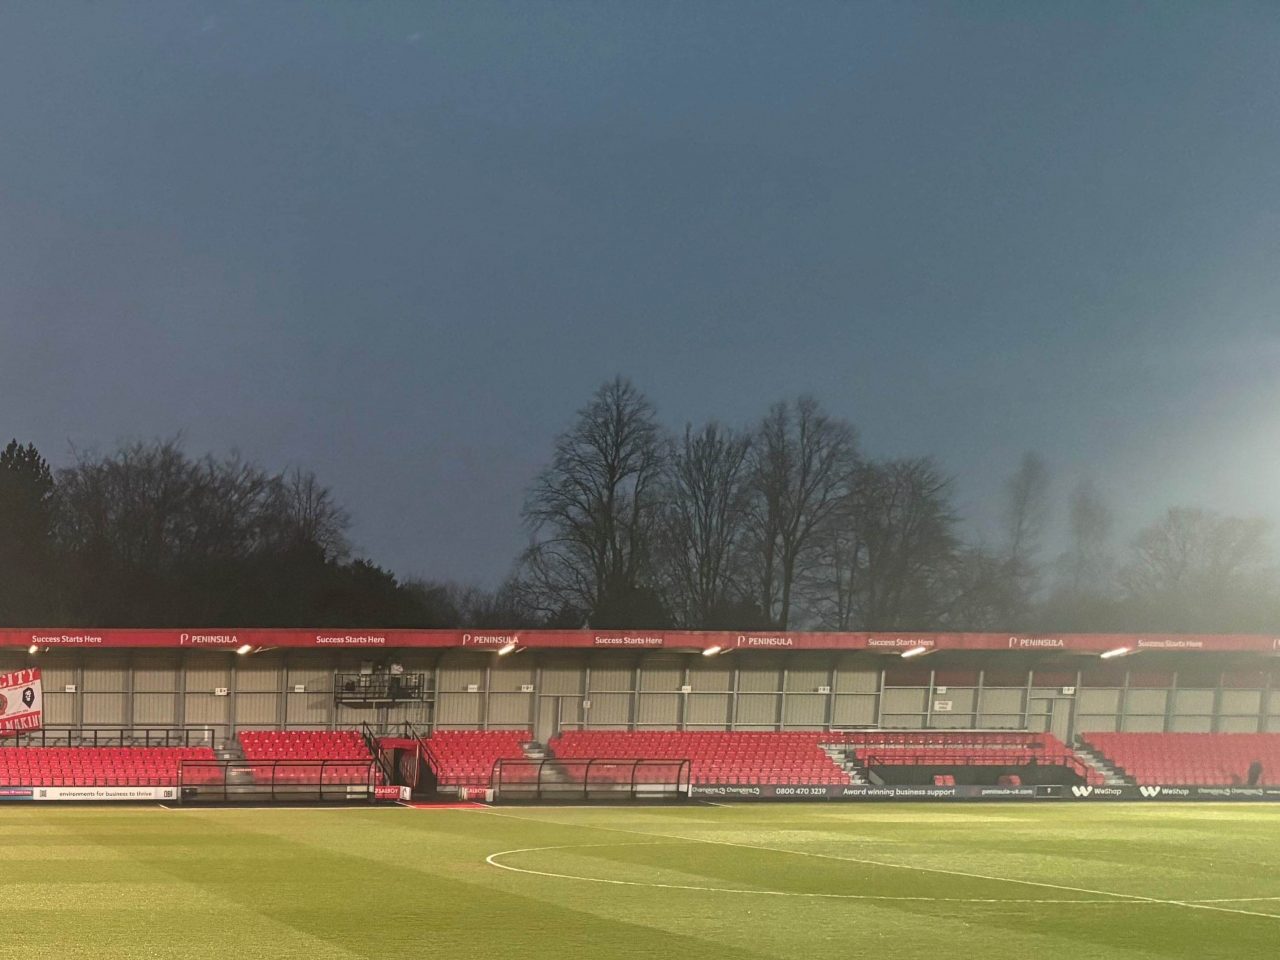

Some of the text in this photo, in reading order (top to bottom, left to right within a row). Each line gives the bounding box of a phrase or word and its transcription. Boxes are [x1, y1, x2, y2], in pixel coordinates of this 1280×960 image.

[32, 635, 101, 643] Success Starts Here
[1020, 639, 1063, 647] PENINSULA
[6, 715, 40, 731] MAKIN
[868, 789, 894, 797] winning
[927, 789, 955, 797] support
[1162, 788, 1189, 796] WeShop
